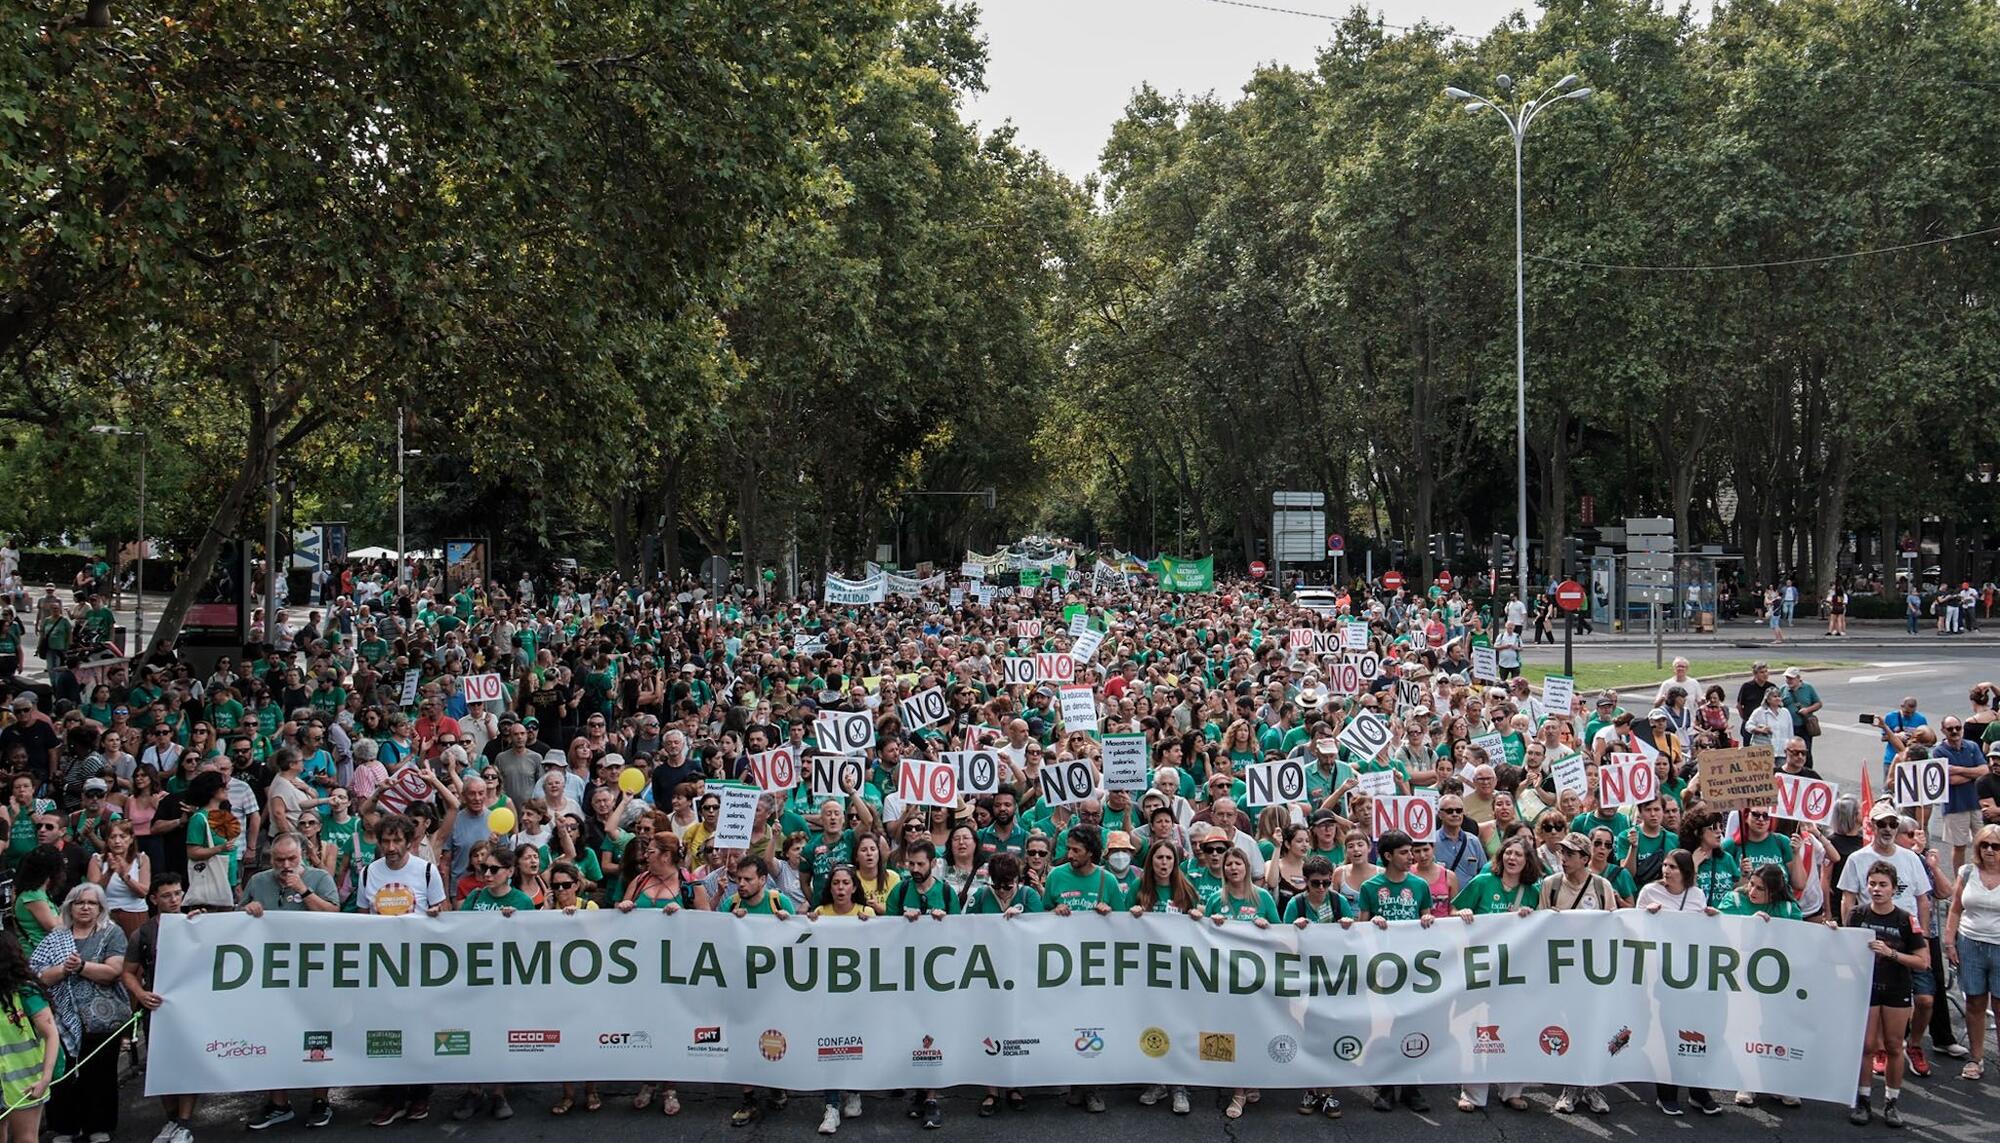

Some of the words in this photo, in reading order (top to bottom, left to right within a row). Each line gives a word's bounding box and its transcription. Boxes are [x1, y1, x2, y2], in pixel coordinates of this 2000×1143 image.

[1019, 621, 1040, 636] NO
[1291, 630, 1312, 646] NO
[1314, 635, 1340, 652] NO
[1003, 660, 1035, 682] NO
[1038, 654, 1073, 679] NO
[1330, 665, 1357, 692] NO
[465, 675, 500, 700] NO
[1400, 680, 1420, 706] NO
[904, 690, 945, 729] NO
[816, 714, 871, 752] NO
[1341, 715, 1387, 756] NO
[750, 749, 793, 790] NO
[814, 759, 864, 794] NO
[900, 760, 955, 804] NO
[1040, 762, 1092, 803] NO
[1249, 761, 1304, 804] NO
[1710, 764, 1724, 775] PT
[1730, 763, 1743, 773] AL
[379, 768, 432, 815] NO
[1601, 762, 1652, 805] NO
[1897, 763, 1946, 804] NO
[1771, 775, 1833, 821] NO
[1374, 798, 1433, 840] NO
[211, 939, 638, 991] DEFENDEMOS
[660, 940, 728, 989] LA
[745, 933, 1015, 993] PÚBLICA.
[1036, 941, 1442, 997] DEFENDEMOS
[1463, 943, 1525, 991] EL
[1547, 938, 1808, 1000] FUTURO.
[510, 1032, 544, 1041] CCOO
[598, 1033, 630, 1044] CGT
[697, 1031, 717, 1040] CNT
[817, 1036, 863, 1047] CONFAPA
[1678, 1043, 1706, 1053] STEM
[1745, 1042, 1773, 1054] UGT
